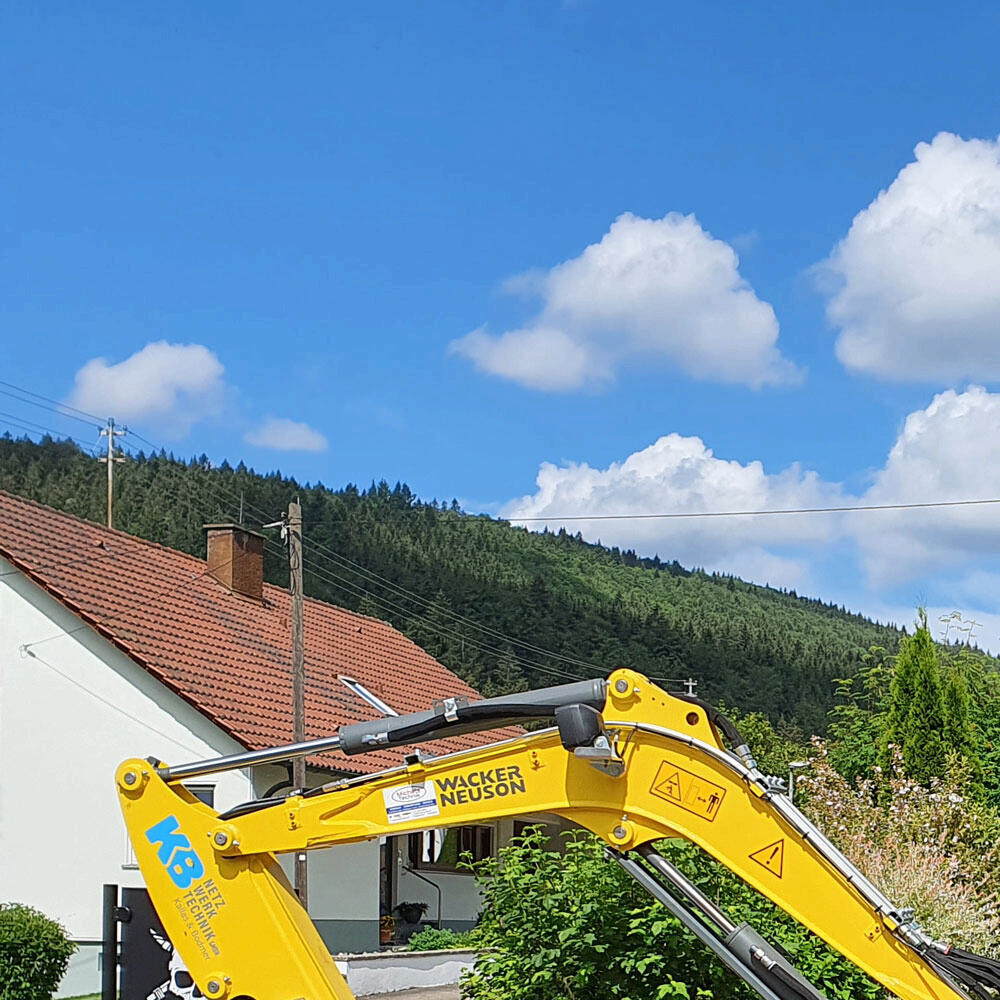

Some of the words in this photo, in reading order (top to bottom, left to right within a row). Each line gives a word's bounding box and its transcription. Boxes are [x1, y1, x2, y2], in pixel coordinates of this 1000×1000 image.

[435, 765, 524, 792] WACKER
[440, 780, 526, 807] NEUSON
[145, 814, 205, 889] KB
[193, 884, 218, 919] WERK
[203, 878, 226, 909] NETZ
[183, 890, 216, 941] TECHNIK
